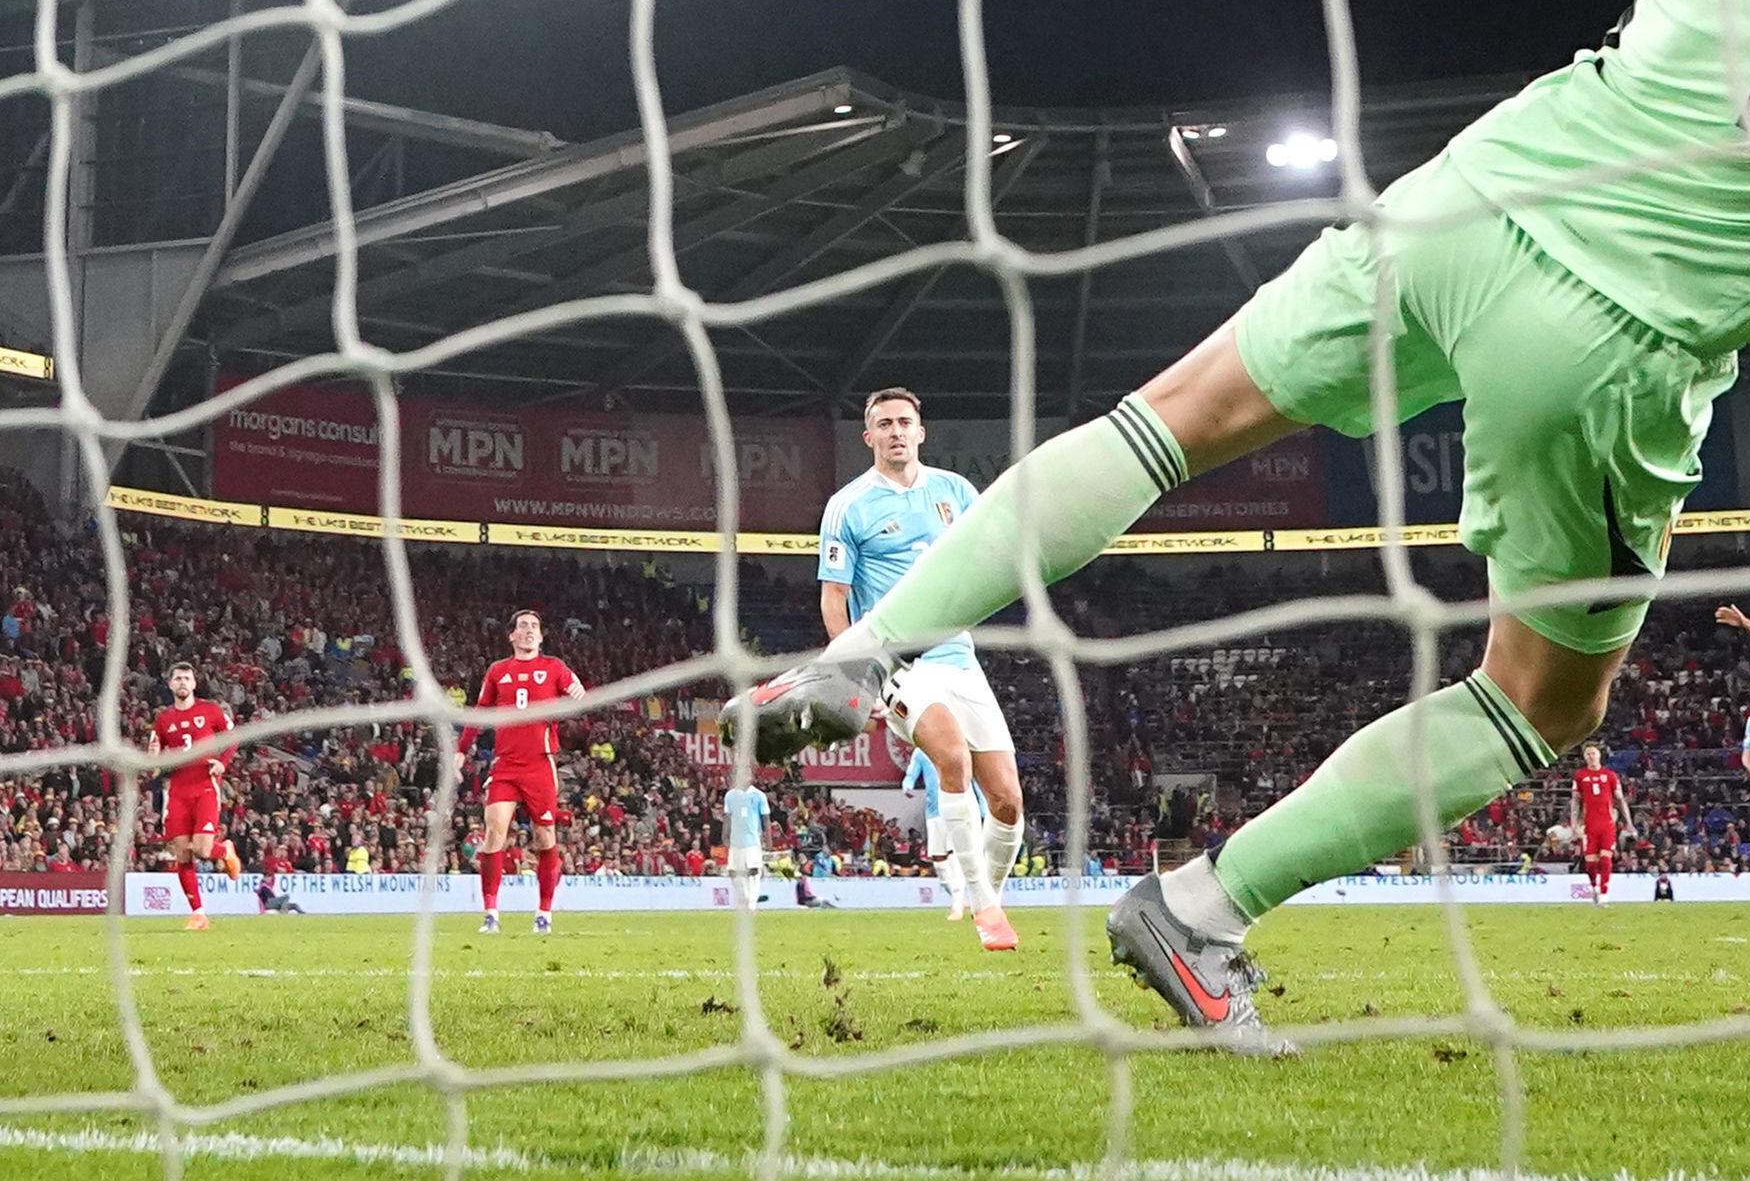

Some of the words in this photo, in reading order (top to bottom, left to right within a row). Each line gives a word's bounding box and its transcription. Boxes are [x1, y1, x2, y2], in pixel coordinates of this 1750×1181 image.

[230, 410, 315, 440] morgans
[318, 421, 381, 445] consul
[1150, 501, 1289, 518] NSERVATORIES
[621, 536, 702, 547] NETWORK
[1151, 537, 1239, 549] NETWORK
[516, 688, 528, 709] 8
[182, 734, 192, 751] 3
[198, 876, 231, 894] ROM
[280, 876, 298, 894] OF
[303, 876, 326, 894] THE
[332, 876, 373, 895] WELSH
[1375, 874, 1433, 886] WELSH
[1446, 873, 1548, 885] OUNTAINS
[38, 888, 109, 909] QUALIFIERS
